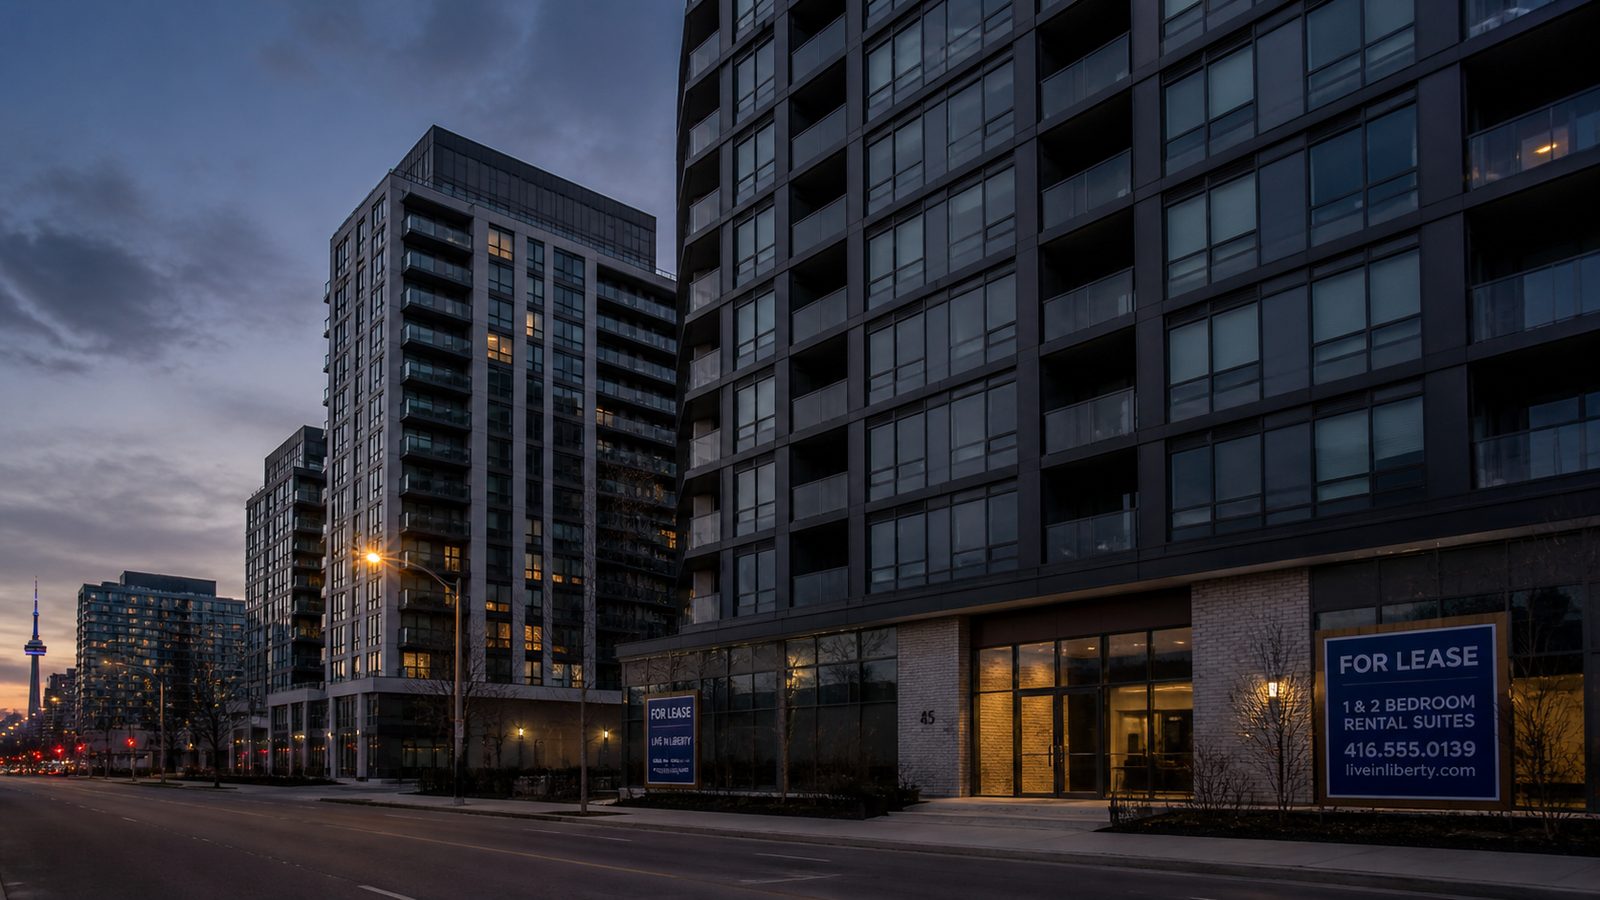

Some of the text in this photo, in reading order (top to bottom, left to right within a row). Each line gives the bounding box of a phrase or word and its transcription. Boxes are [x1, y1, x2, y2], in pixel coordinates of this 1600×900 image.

[1340, 646, 1478, 674] FOR LEASE
[1343, 695, 1475, 713] 1 & 2 BEDROOM
[651, 706, 691, 720] FOR LEASE
[1344, 714, 1475, 731] RENTAL SUITES
[1344, 741, 1476, 758] 416.555.0139
[1346, 764, 1476, 779] liveinliberty.com
